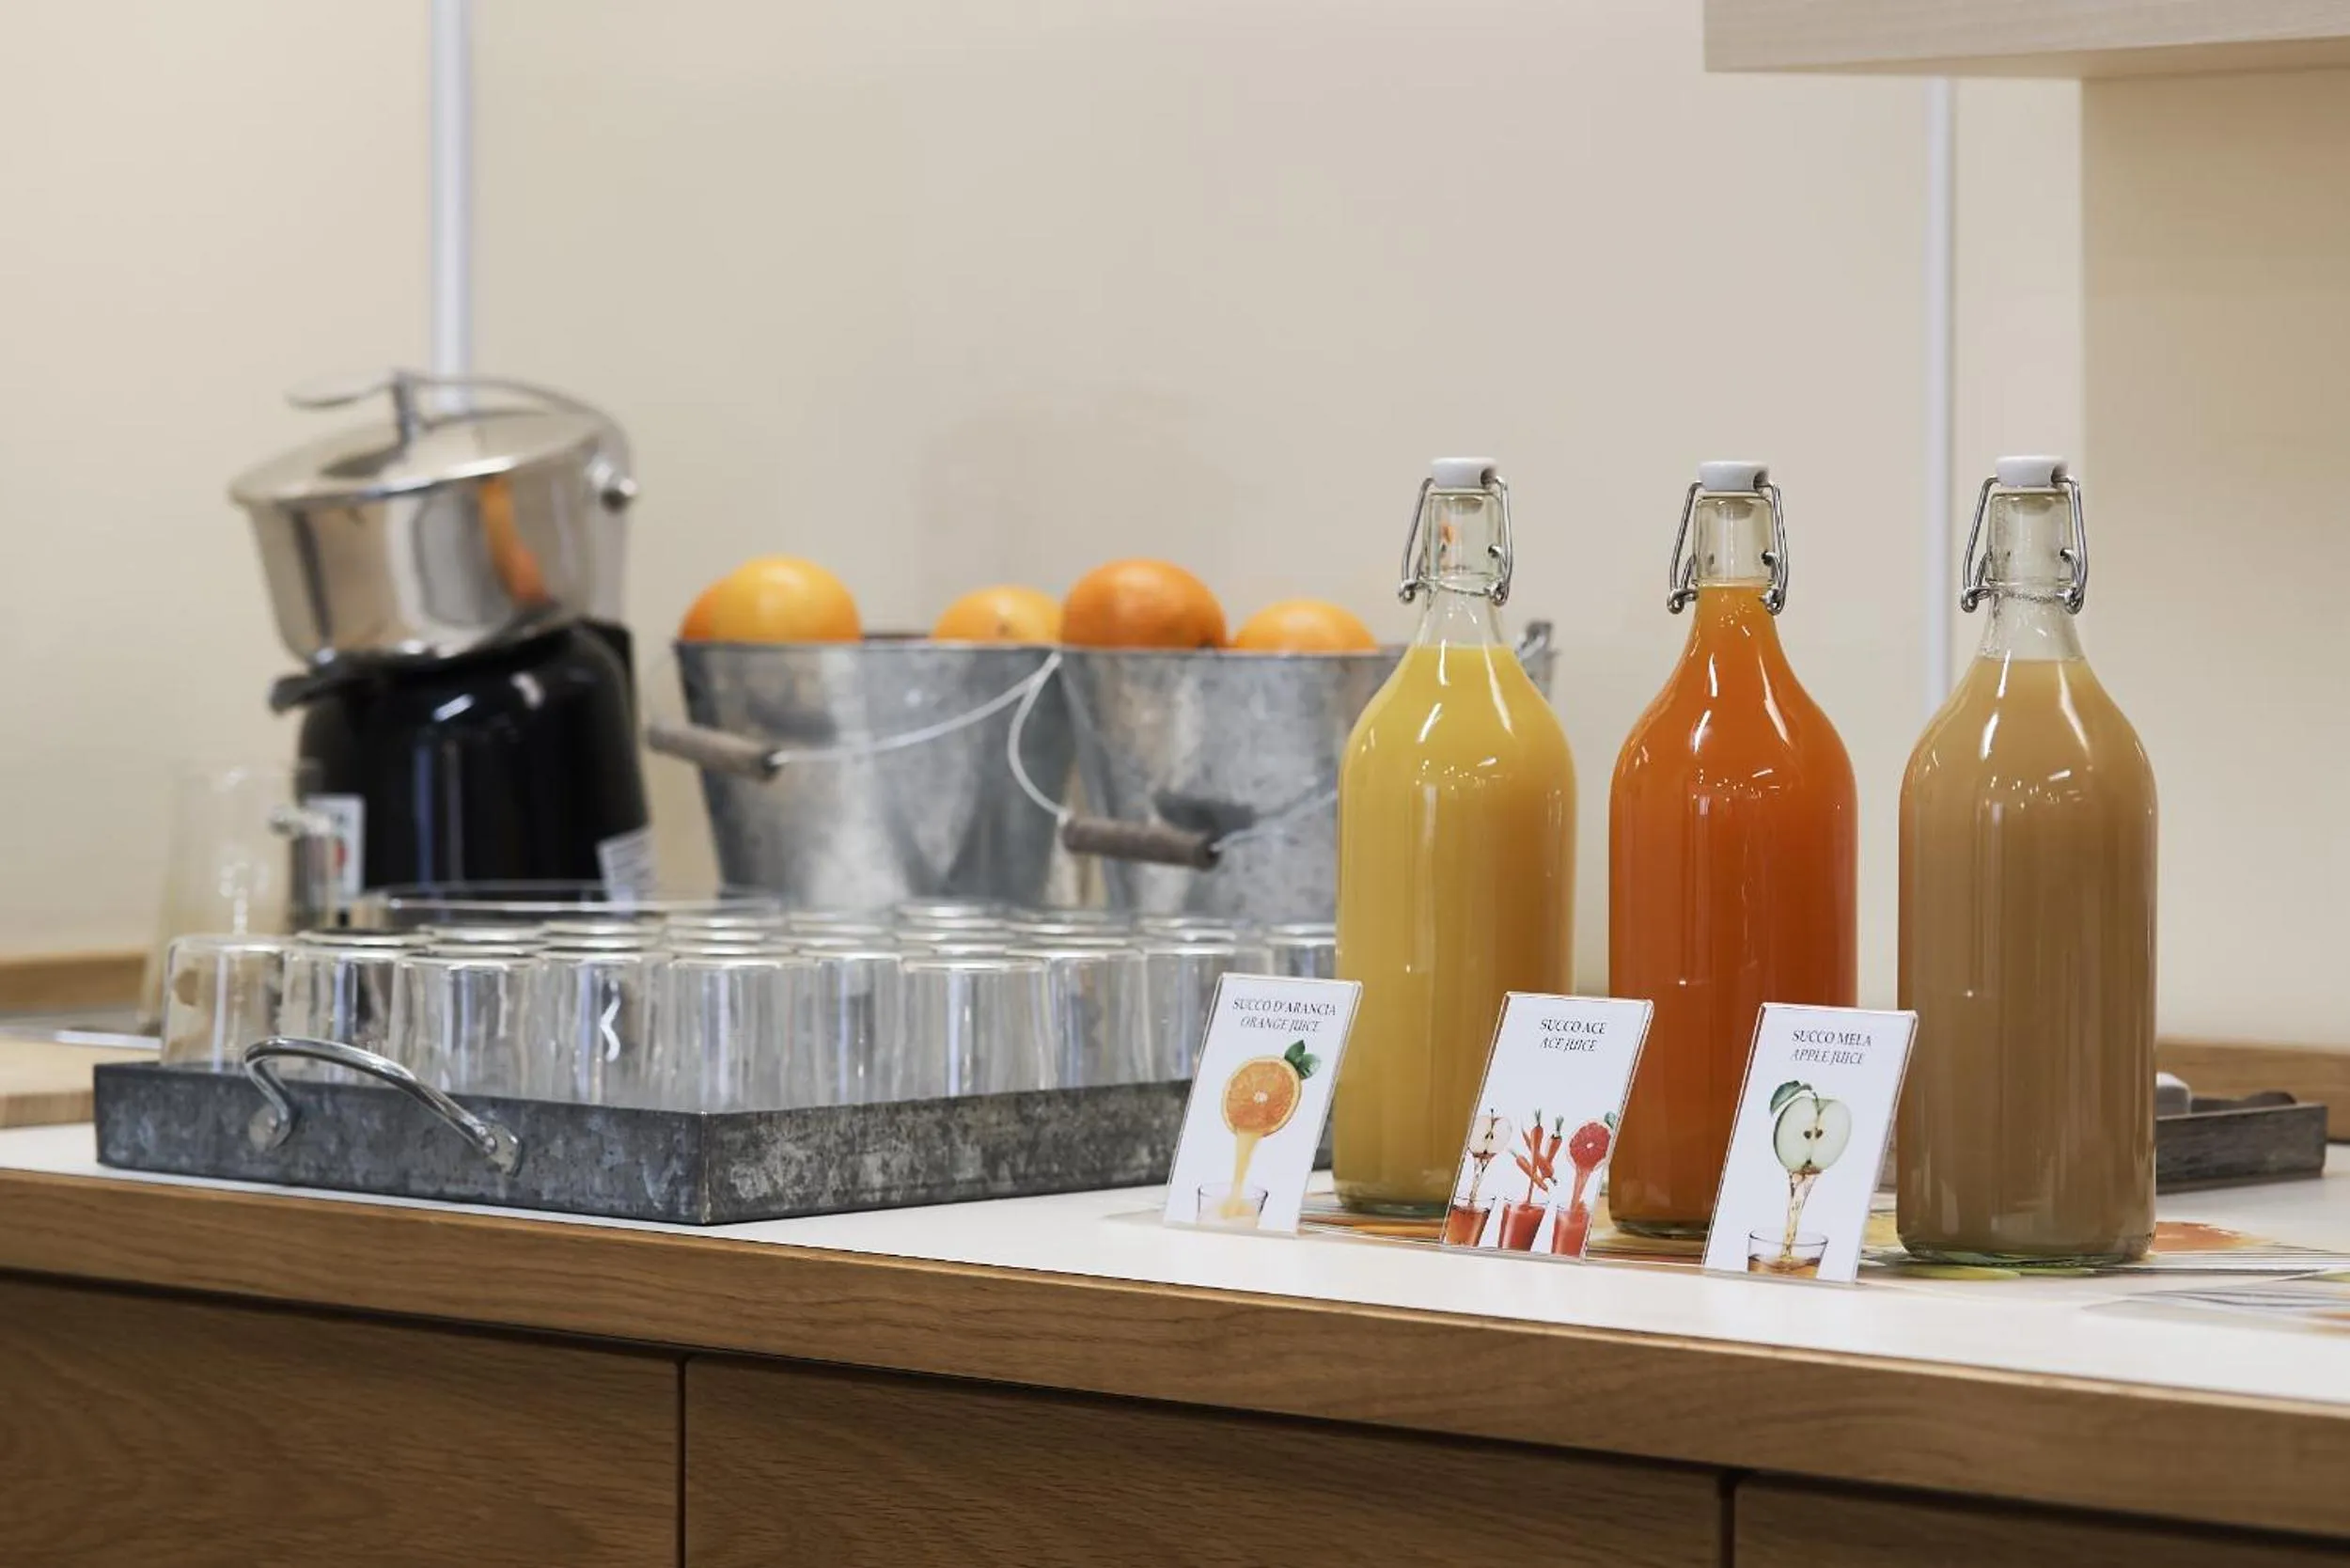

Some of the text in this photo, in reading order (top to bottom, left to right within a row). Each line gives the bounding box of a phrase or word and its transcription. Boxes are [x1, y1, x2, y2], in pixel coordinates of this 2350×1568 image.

[1232, 998, 1271, 1012] SUCCO
[1240, 1016, 1320, 1033] ORANGE JUICE
[1540, 1019, 1607, 1035] SUCCO ACE
[1541, 1037, 1597, 1052] ACE JUICE
[1792, 1029, 1872, 1046] SUCCO MELA
[1792, 1048, 1864, 1065] APPLE JUICE
